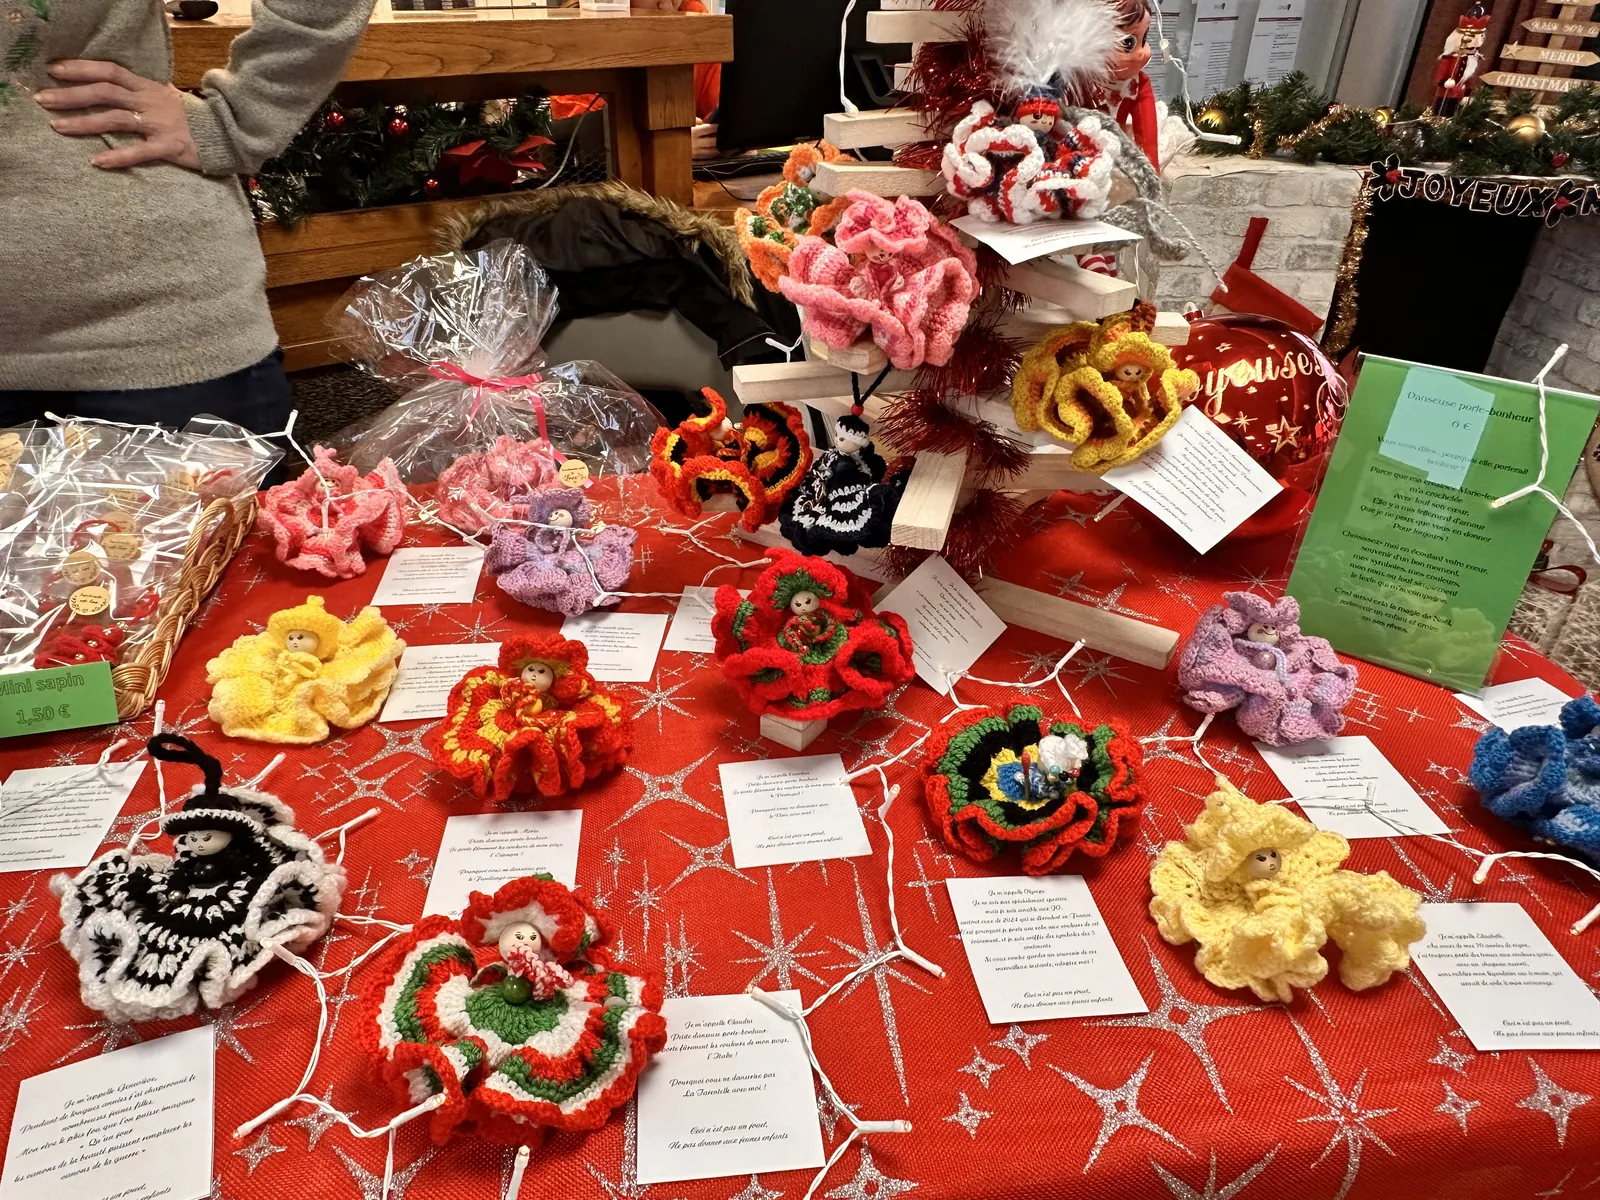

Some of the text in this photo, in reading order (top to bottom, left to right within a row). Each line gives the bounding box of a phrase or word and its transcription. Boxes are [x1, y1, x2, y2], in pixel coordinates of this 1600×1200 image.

[1540, 51, 1583, 63] MERRY
[1497, 73, 1579, 93] CHRISTMA
[1399, 169, 1556, 218] JOYEUX
[1407, 391, 1534, 423] Danseuse porte-bonheur
[1451, 420, 1472, 431] 6 €
[1479, 459, 1493, 467] elle
[1370, 466, 1392, 478] Parce
[1394, 472, 1408, 481] que
[1410, 476, 1422, 484] ma
[1394, 492, 1413, 502] Avec
[1415, 498, 1429, 506] tout
[1360, 504, 1376, 514] Que
[1395, 513, 1414, 524] peux
[1416, 518, 1430, 527] que
[1432, 522, 1451, 532] vous
[1453, 528, 1462, 536] en
[1464, 530, 1491, 543] donner
[1373, 497, 1387, 506] Elle
[1401, 505, 1415, 513] mis
[1417, 508, 1451, 522] tellement
[1453, 516, 1485, 531] d'amour
[1393, 523, 1444, 542] Pour toujours
[1361, 545, 1392, 558] souvenir
[1411, 558, 1425, 567] bon
[1384, 540, 1399, 549] moi
[1400, 545, 1410, 553] en
[1411, 547, 1444, 562] écoutant
[1445, 557, 1465, 567] votre
[1350, 563, 1366, 571] mon
[1398, 575, 1413, 584] tout
[1353, 553, 1369, 562] mes
[1408, 568, 1425, 576] mes
[1385, 611, 1408, 623] enfant
[1398, 606, 1420, 617] magie
[0, 672, 85, 696] Mini sapin
[16, 704, 70, 725] 1,50 €
[684, 1021, 694, 1029] Je
[694, 1020, 725, 1028] m'appelle
[670, 1033, 691, 1041] Petite
[719, 1040, 746, 1048] couleurs
[669, 1078, 704, 1087] Pourquoi
[696, 1087, 730, 1097] Tarentelle
[20, 1077, 188, 1134] Pendant de longues années j'ai chaperonné
[64, 1100, 75, 1109] Je
[76, 1088, 114, 1104] m'appelle
[16, 1145, 38, 1158] Mon
[40, 1141, 57, 1150] rêve
[66, 1132, 84, 1143] plus
[86, 1127, 100, 1137] fou
[103, 1122, 118, 1131] que
[119, 1115, 134, 1125] l'on
[135, 1109, 160, 1121] puisse
[161, 1097, 195, 1112] imaginer
[62, 1114, 106, 1132] nombreuses
[108, 1106, 132, 1119] jeunes
[89, 1128, 134, 1146] Qu'un jour
[690, 1126, 706, 1134] Ceci
[706, 1125, 721, 1133] n'est
[14, 1174, 25, 1182] les
[27, 1165, 56, 1178] canons
[58, 1159, 67, 1168] de
[69, 1157, 78, 1165] la
[108, 1137, 141, 1153] puissent
[142, 1124, 181, 1142] remplacer
[182, 1120, 192, 1128] les
[668, 1141, 681, 1149] Ne
[682, 1142, 696, 1150] pas
[697, 1139, 721, 1147] donner
[739, 1136, 761, 1144] jeunes
[762, 1132, 788, 1141] enfants
[60, 1150, 139, 1180] canons de la guerre
